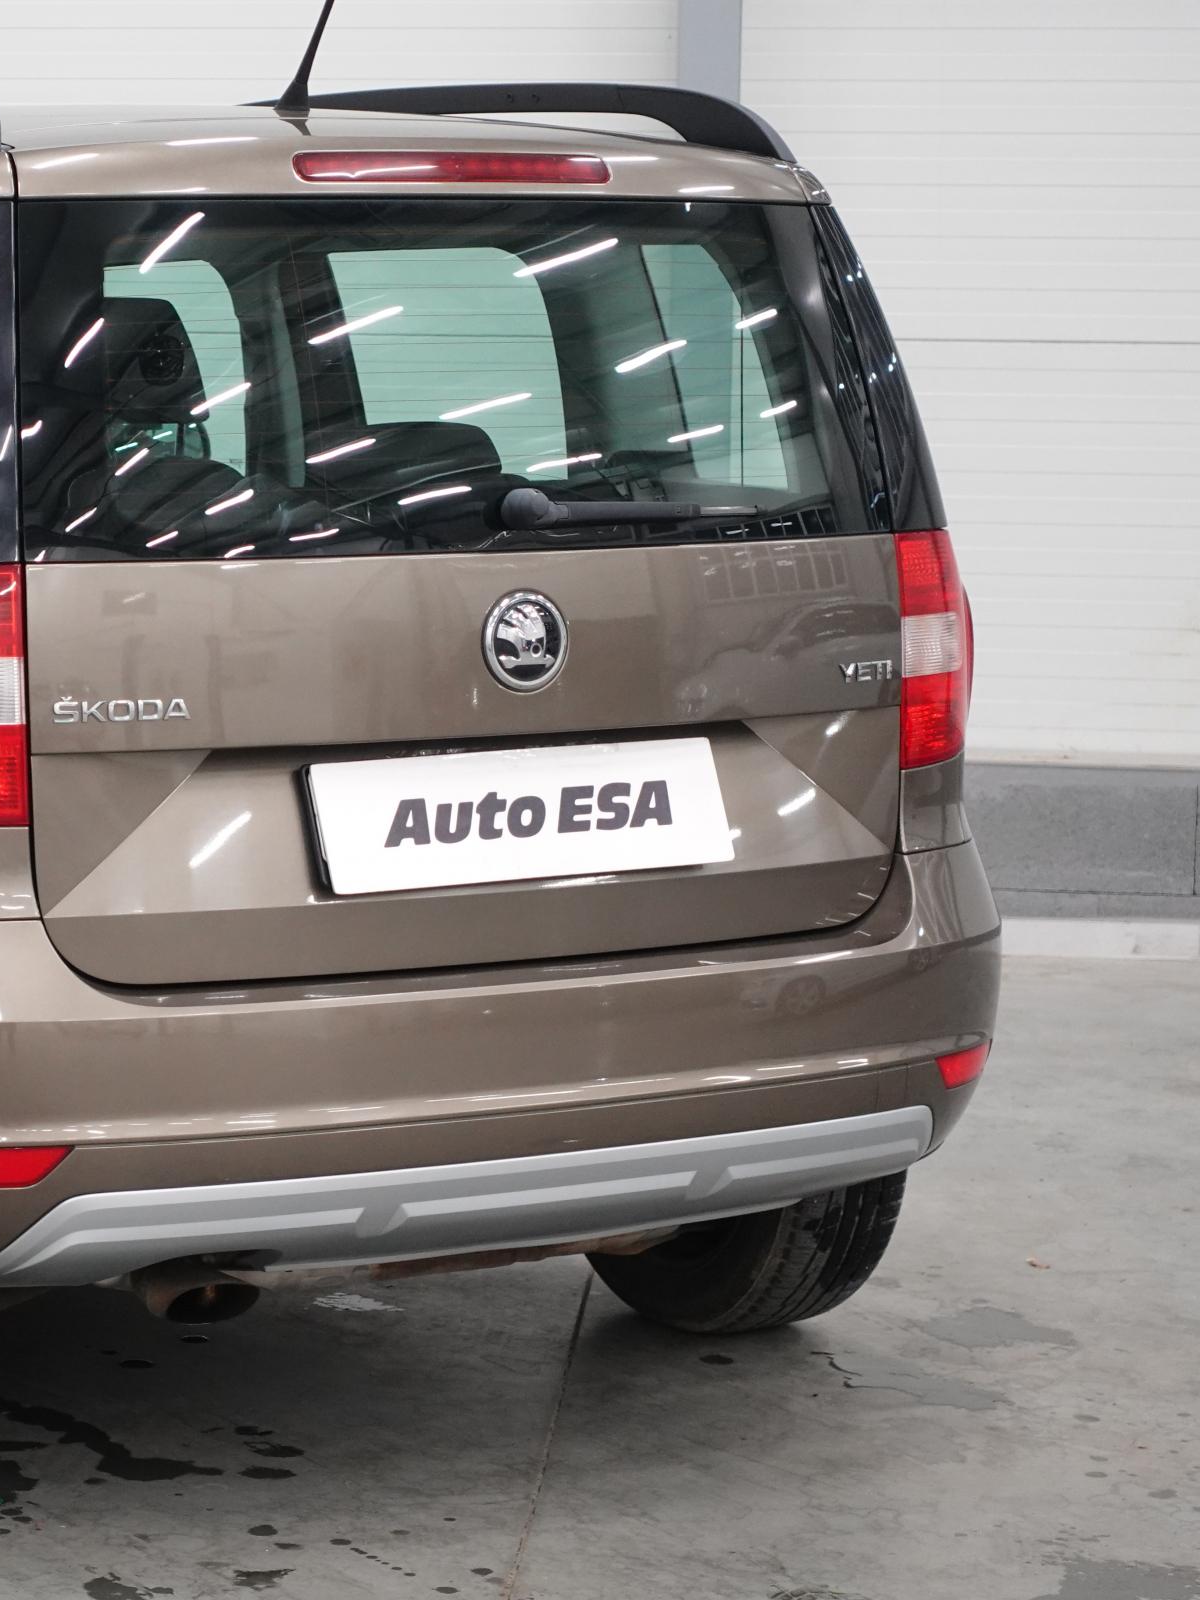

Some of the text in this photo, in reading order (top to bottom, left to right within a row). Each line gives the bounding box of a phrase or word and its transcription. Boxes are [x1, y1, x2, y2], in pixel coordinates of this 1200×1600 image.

[839, 660, 893, 683] YETI
[53, 696, 192, 724] ŠKODA
[384, 780, 673, 848] Auto ESA
